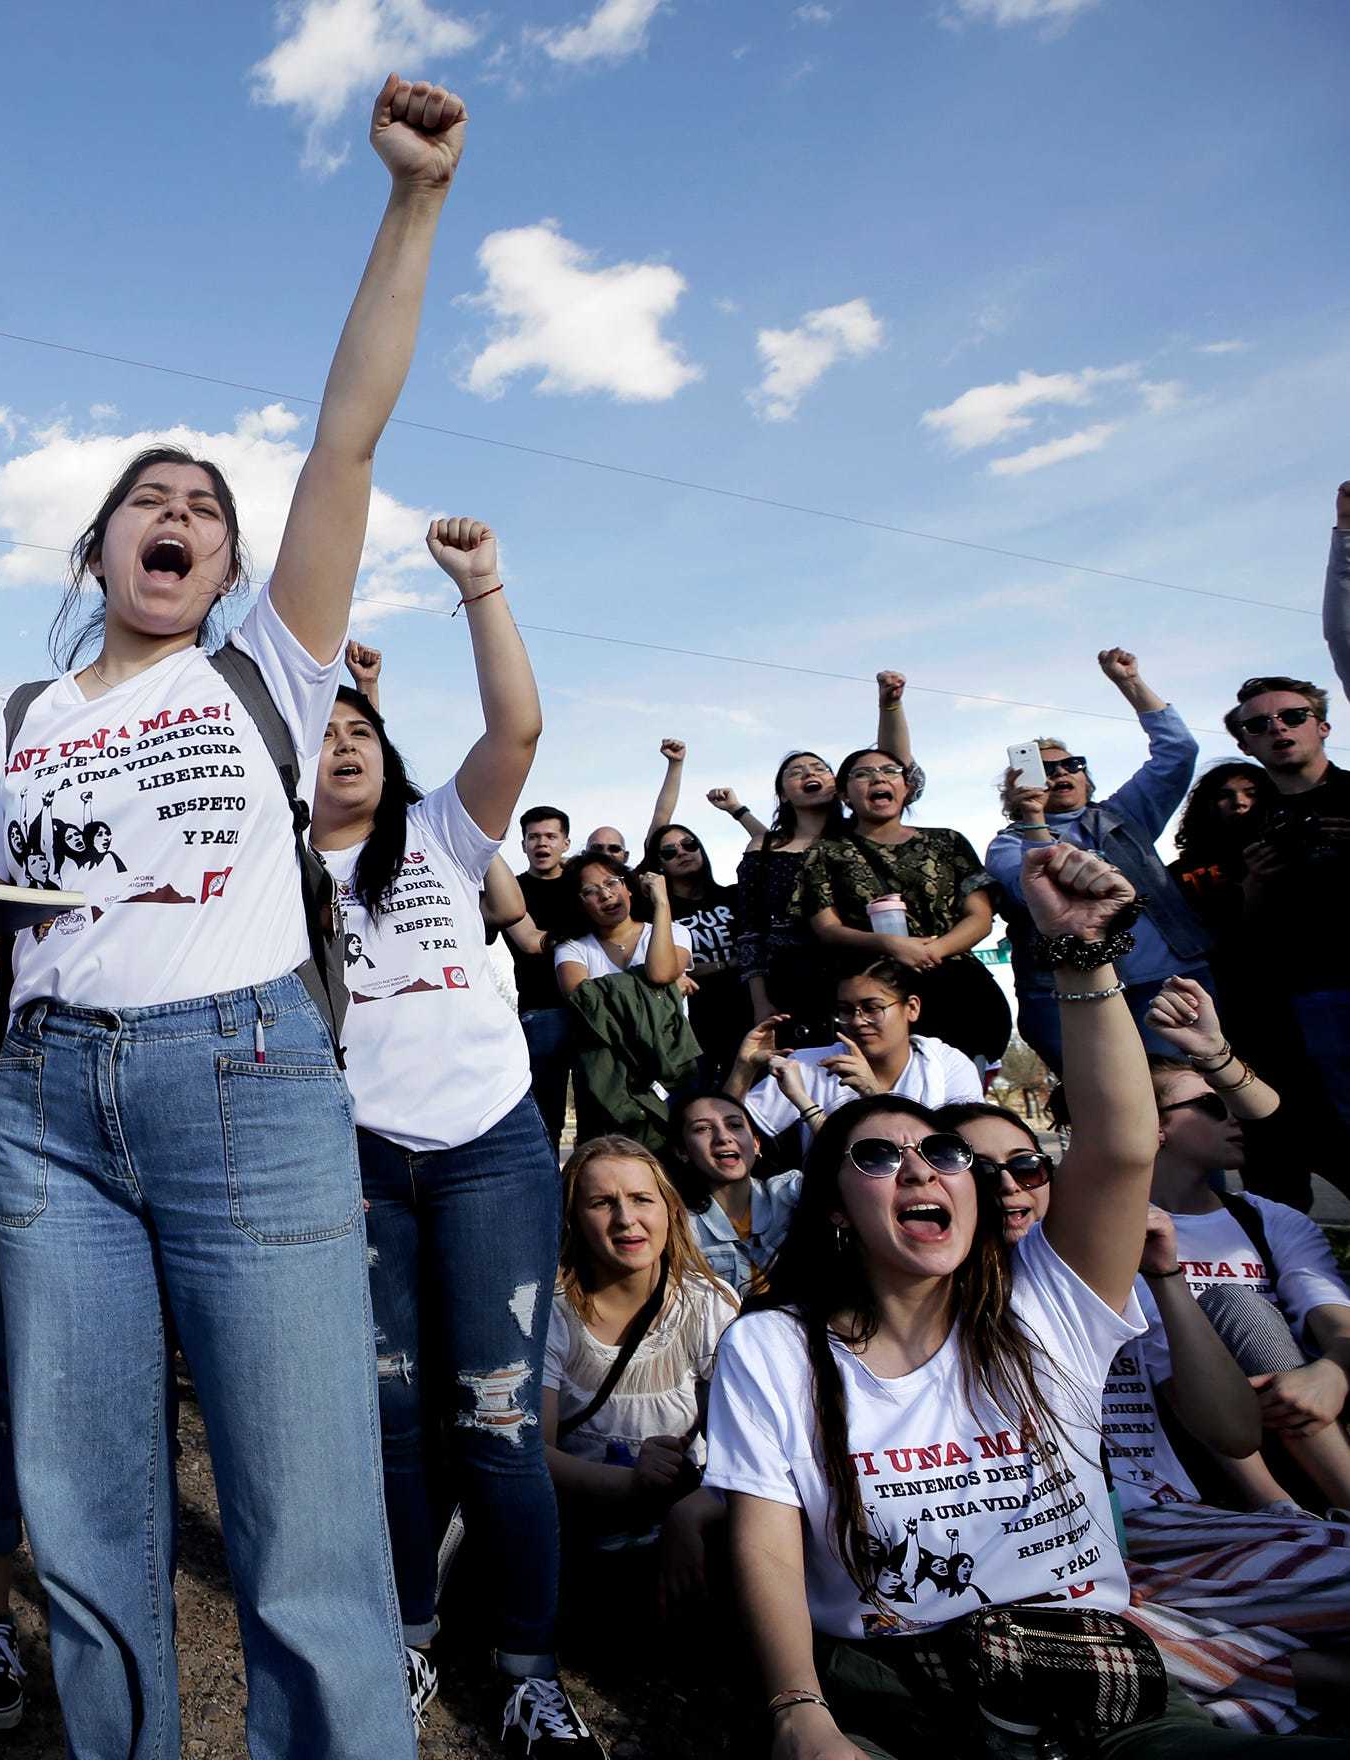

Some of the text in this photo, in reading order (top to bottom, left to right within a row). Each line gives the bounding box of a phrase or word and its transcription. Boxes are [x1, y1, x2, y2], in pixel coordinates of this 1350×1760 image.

[139, 703, 231, 736] MAS!
[136, 724, 235, 751] DERECHO
[58, 744, 242, 791] A UNA VIDA DIGNA
[138, 764, 245, 791] LIBERTAD
[156, 796, 246, 821] RESPETO
[183, 829, 240, 845] Y PAZ!
[403, 880, 444, 891] DIGNA
[419, 940, 430, 951] Y
[884, 1441, 972, 1474] UNA
[875, 1469, 981, 1499] TENEMOS
[920, 1505, 936, 1522] A
[936, 1500, 981, 1521] UNA
[979, 1493, 1030, 1512] VIDA
[1001, 1491, 1087, 1536] LIBERTAD
[1018, 1519, 1092, 1560] RESPETO
[1051, 1545, 1102, 1581] Y PAZ!
